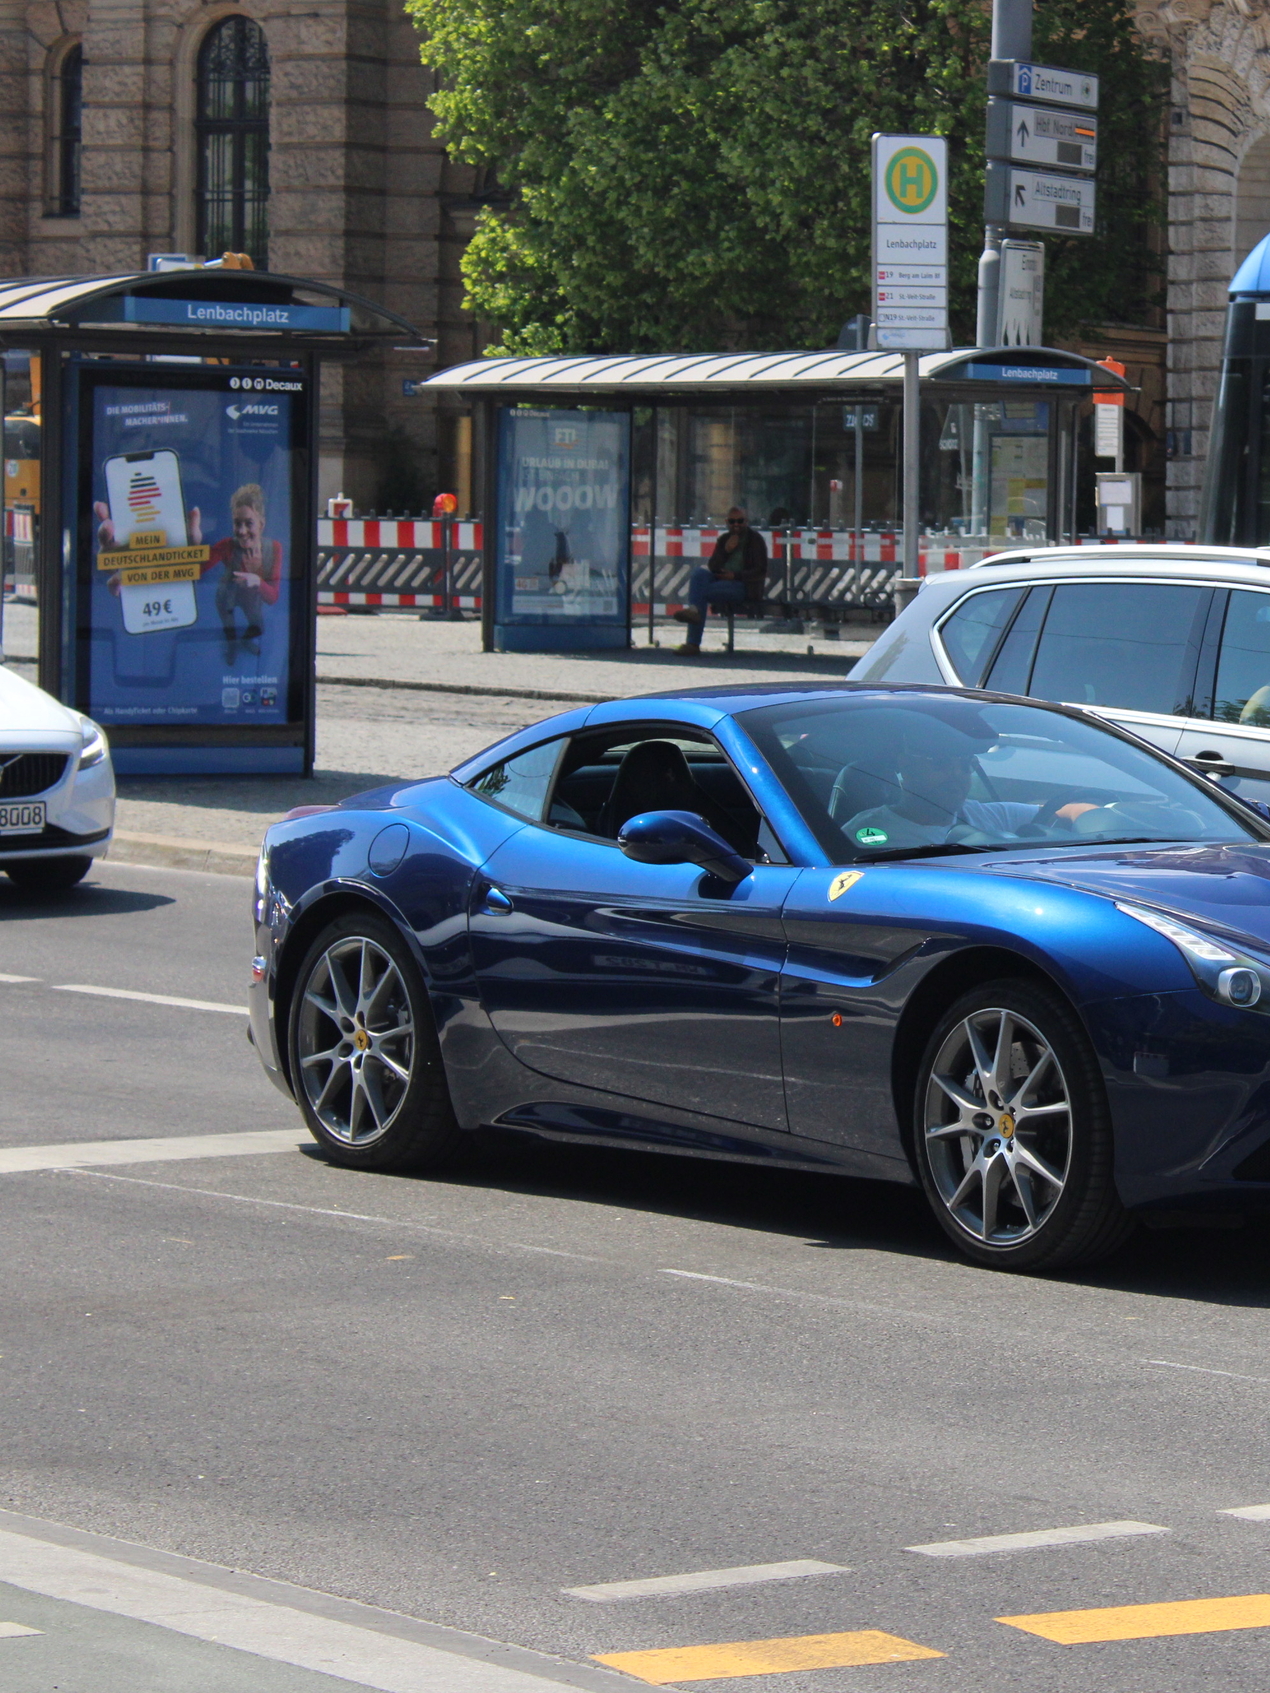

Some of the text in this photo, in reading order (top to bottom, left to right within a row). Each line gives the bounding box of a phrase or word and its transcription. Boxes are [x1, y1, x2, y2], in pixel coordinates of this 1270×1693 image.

[1035, 73, 1073, 96] Zentrum
[1036, 116, 1051, 132] Hbf
[1084, 149, 1094, 165] frei
[1035, 181, 1082, 205] Altstadtring
[1082, 212, 1093, 227] frei
[886, 239, 937, 250] Lenbachplatz
[187, 304, 289, 325] Lenbachplatz
[1002, 367, 1058, 381] Lenbachplatz
[106, 402, 169, 415] DIE MOBILITÄTS-
[242, 404, 279, 415] MVG
[522, 457, 561, 469] URLAUB
[563, 459, 575, 469] IN
[514, 484, 618, 512] WOOOW
[135, 535, 161, 545] MEIN
[103, 549, 204, 567] DEUTSCHLANDTICKET
[127, 568, 194, 582] VON DER MVG
[222, 675, 278, 685] Hier bestellen
